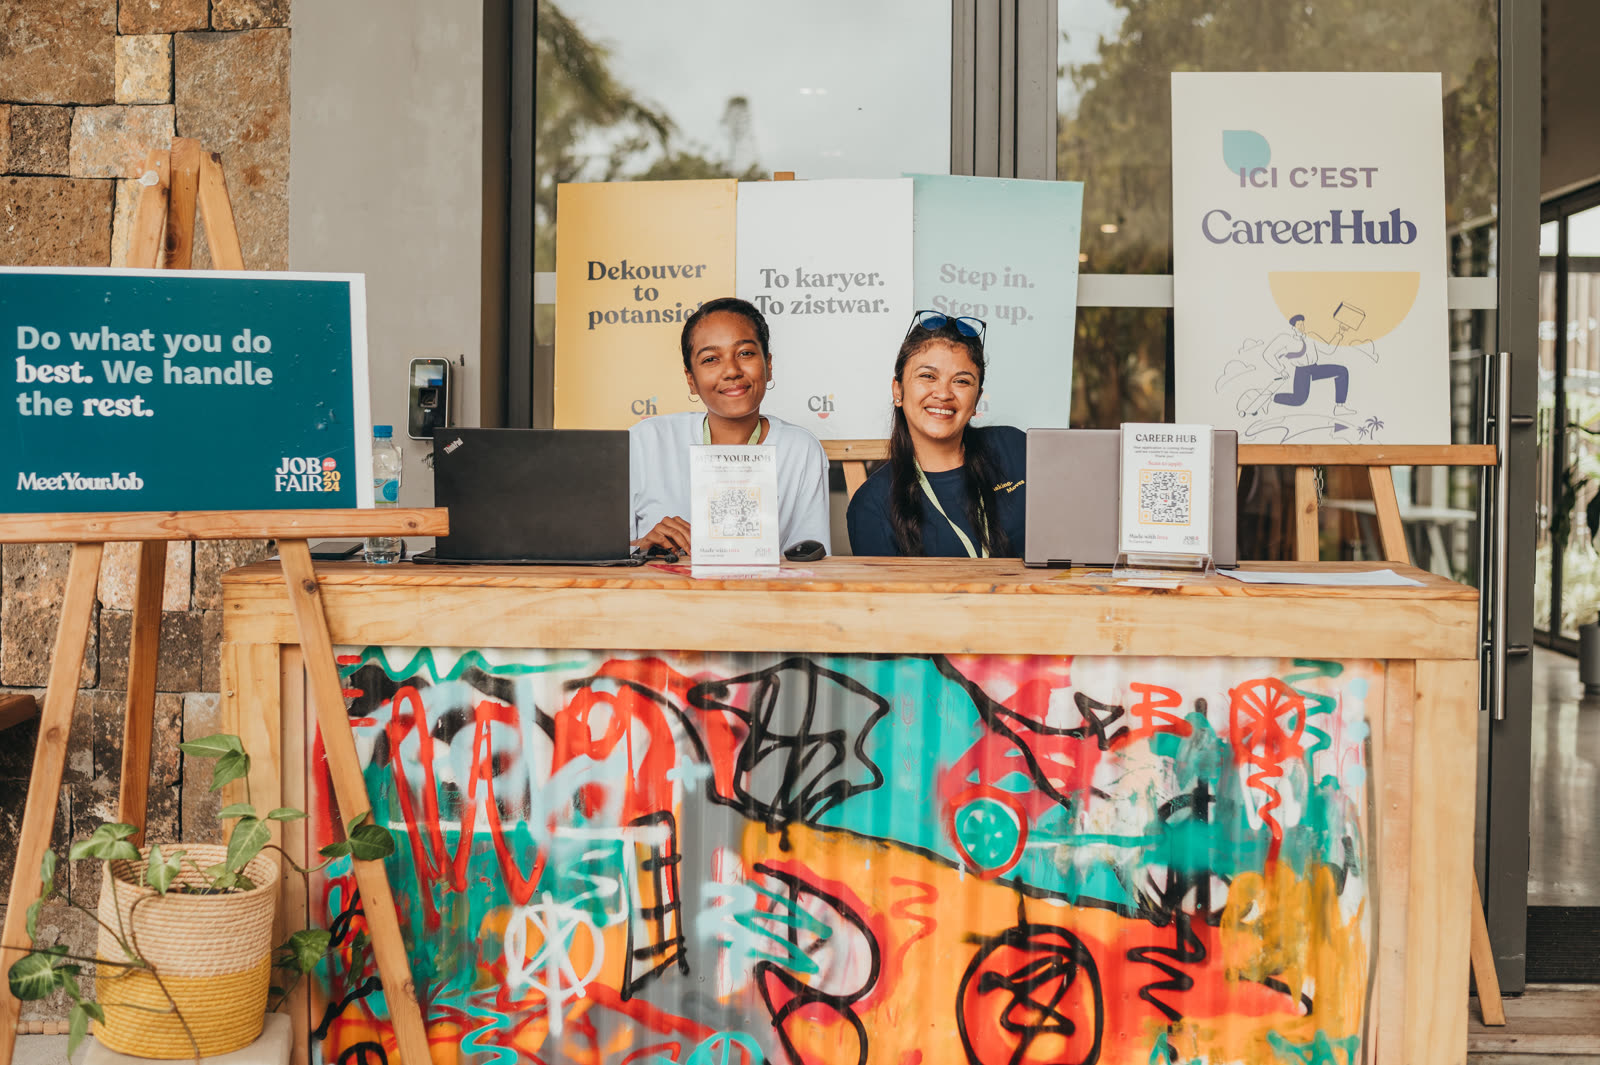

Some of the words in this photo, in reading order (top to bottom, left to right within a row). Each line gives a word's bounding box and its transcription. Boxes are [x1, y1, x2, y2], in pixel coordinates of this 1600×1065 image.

[1239, 167, 1278, 188] ICI
[1289, 166, 1379, 189] C’EST
[1201, 208, 1418, 245] CareerHub
[587, 259, 707, 281] Dekouver
[759, 268, 790, 288] To
[795, 266, 885, 293] karyer.
[939, 263, 998, 291] Step
[1003, 266, 1035, 289] in.
[633, 285, 659, 301] to
[587, 300, 703, 331] potansie
[754, 295, 784, 316] To
[790, 293, 890, 315] zistwar.
[931, 295, 989, 319] Step
[995, 304, 1034, 326] up.
[16, 326, 61, 350] Do
[68, 325, 156, 352] what
[162, 334, 222, 358] you
[231, 328, 272, 353] do
[15, 355, 94, 384] best.
[101, 360, 154, 384] We
[163, 356, 273, 385] handle
[16, 391, 73, 416] the
[82, 395, 154, 417] rest.
[630, 398, 658, 416] Ch
[807, 395, 835, 412] Ch
[1135, 433, 1173, 443] CAREER
[1175, 434, 1197, 443] HUB
[276, 457, 322, 474] JOB
[723, 454, 750, 462] YOUR
[16, 471, 144, 491] MeetYourJob
[274, 474, 323, 492] FAIR
[323, 471, 341, 481] 20
[323, 481, 340, 492] 24
